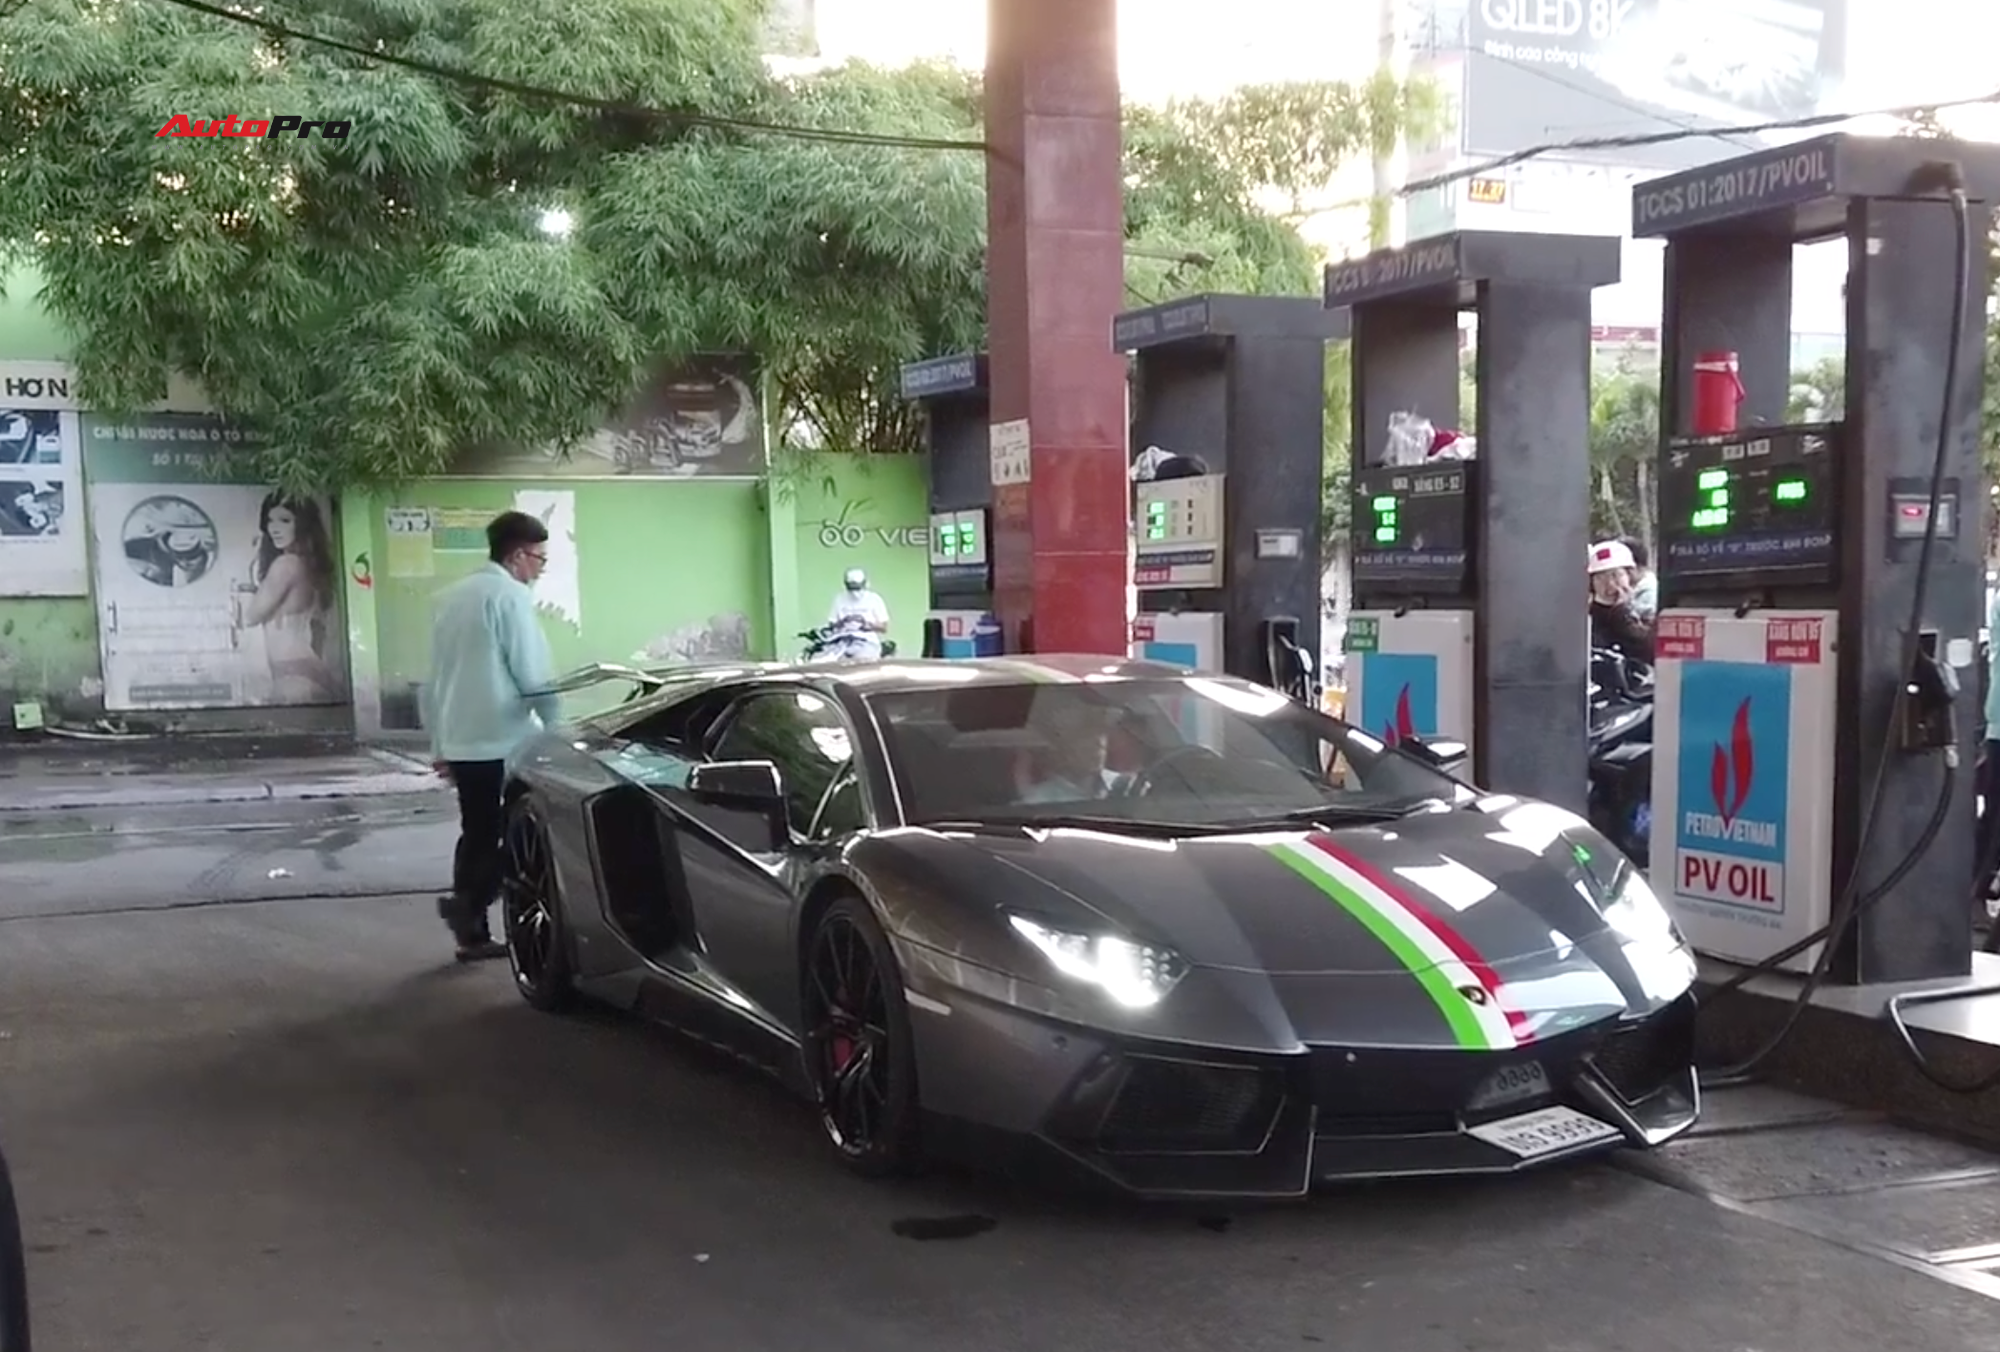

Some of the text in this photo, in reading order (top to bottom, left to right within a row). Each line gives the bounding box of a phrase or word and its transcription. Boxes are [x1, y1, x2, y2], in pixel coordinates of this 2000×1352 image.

[1480, 0, 1583, 36] QLED
[1515, 46, 1542, 62] cao
[1638, 150, 1828, 223] TCCS 01:2017/PVOIL
[1684, 811, 1777, 848] PETROVIETNAM
[1684, 855, 1775, 903] PV OIL
